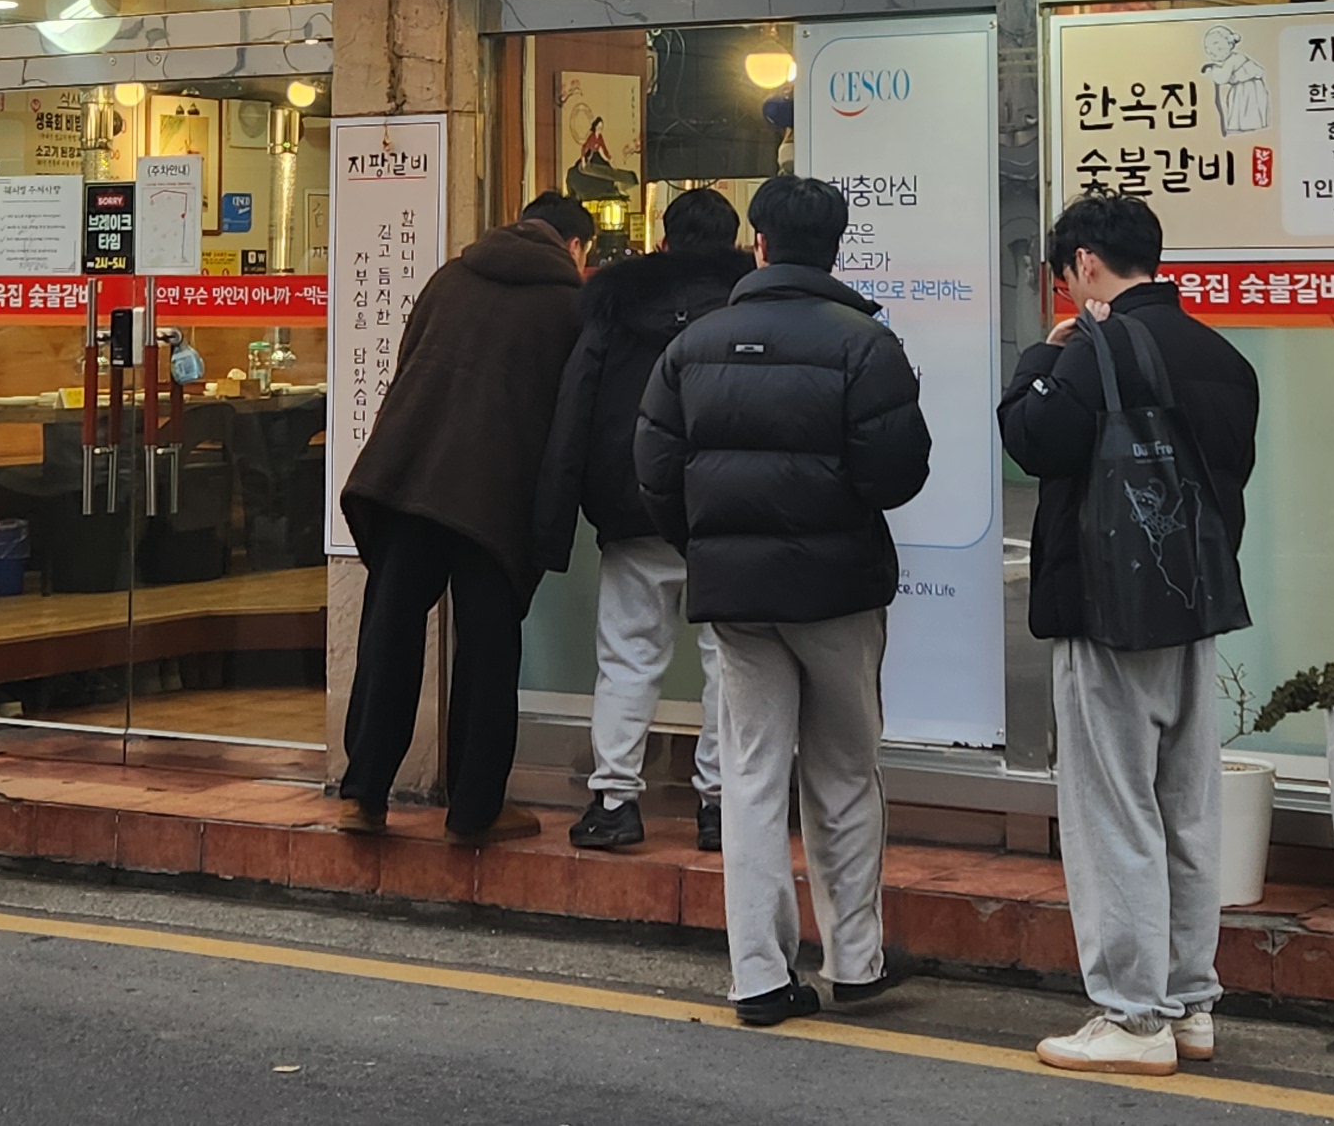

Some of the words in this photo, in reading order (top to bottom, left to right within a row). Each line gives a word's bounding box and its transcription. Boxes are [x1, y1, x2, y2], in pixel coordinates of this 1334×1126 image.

[829, 68, 911, 103] CESCO
[1075, 81, 1199, 131] 한옥집
[348, 152, 429, 178] 지팡갈비
[1076, 146, 1235, 198] 숯불갈비
[98, 233, 122, 251] 타임
[840, 223, 875, 245] 곳은
[144, 287, 180, 306] 으면
[182, 286, 209, 306] 무슨
[212, 286, 249, 306] 맛인지
[251, 286, 291, 306] 아니까
[294, 285, 328, 306] ~먹는
[842, 280, 907, 300] 기적으로
[910, 280, 973, 301] 관리하는
[916, 582, 934, 596] ON
[935, 582, 956, 597] Life
